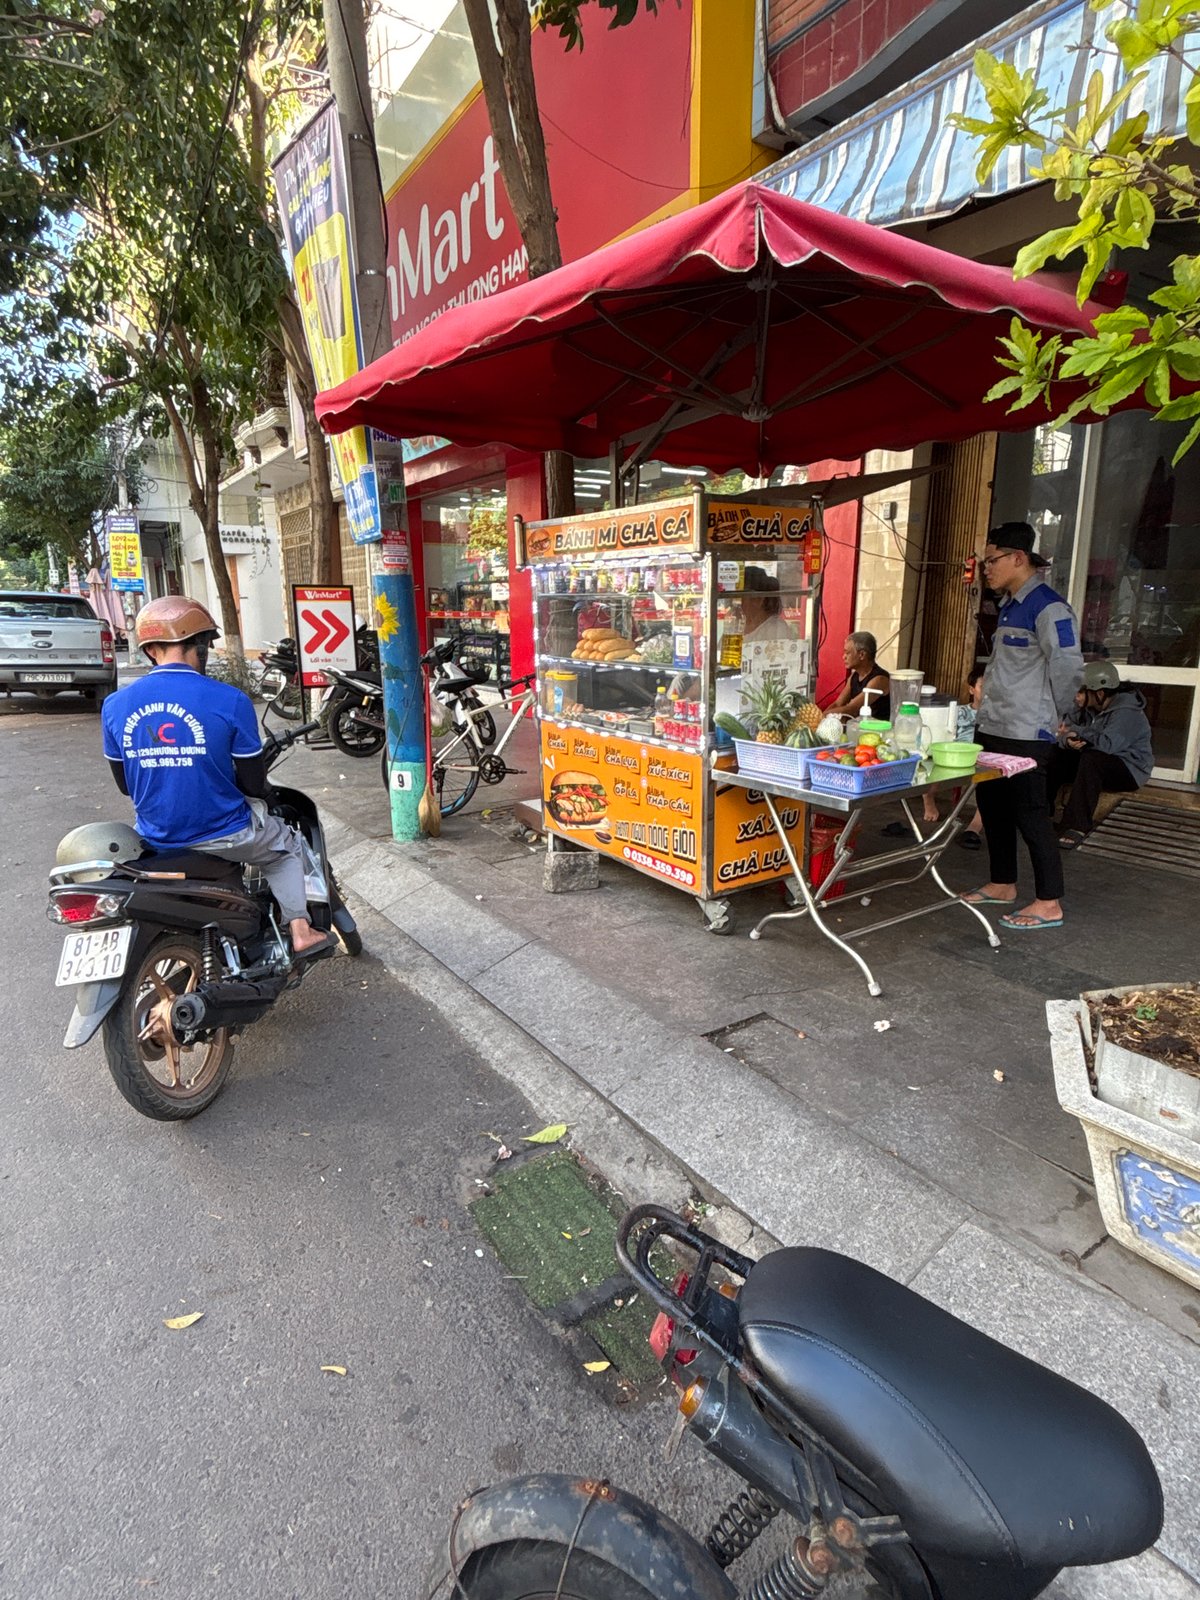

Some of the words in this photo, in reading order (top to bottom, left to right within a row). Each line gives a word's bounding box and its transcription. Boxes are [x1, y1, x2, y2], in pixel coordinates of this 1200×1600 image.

[387, 135, 504, 321] nMart
[502, 244, 529, 285] HẠN
[553, 526, 595, 551] BÁNH
[597, 520, 618, 546] MÌ
[620, 512, 658, 544] CHẢ
[662, 509, 690, 541] CÁ
[741, 509, 783, 540] CHẢ
[785, 513, 813, 540] CÁ
[138, 702, 164, 716] LẠNH
[166, 702, 186, 718] VĂN
[397, 773, 405, 788] 9
[735, 814, 766, 843] XÁ
[718, 849, 760, 881] CHẢ
